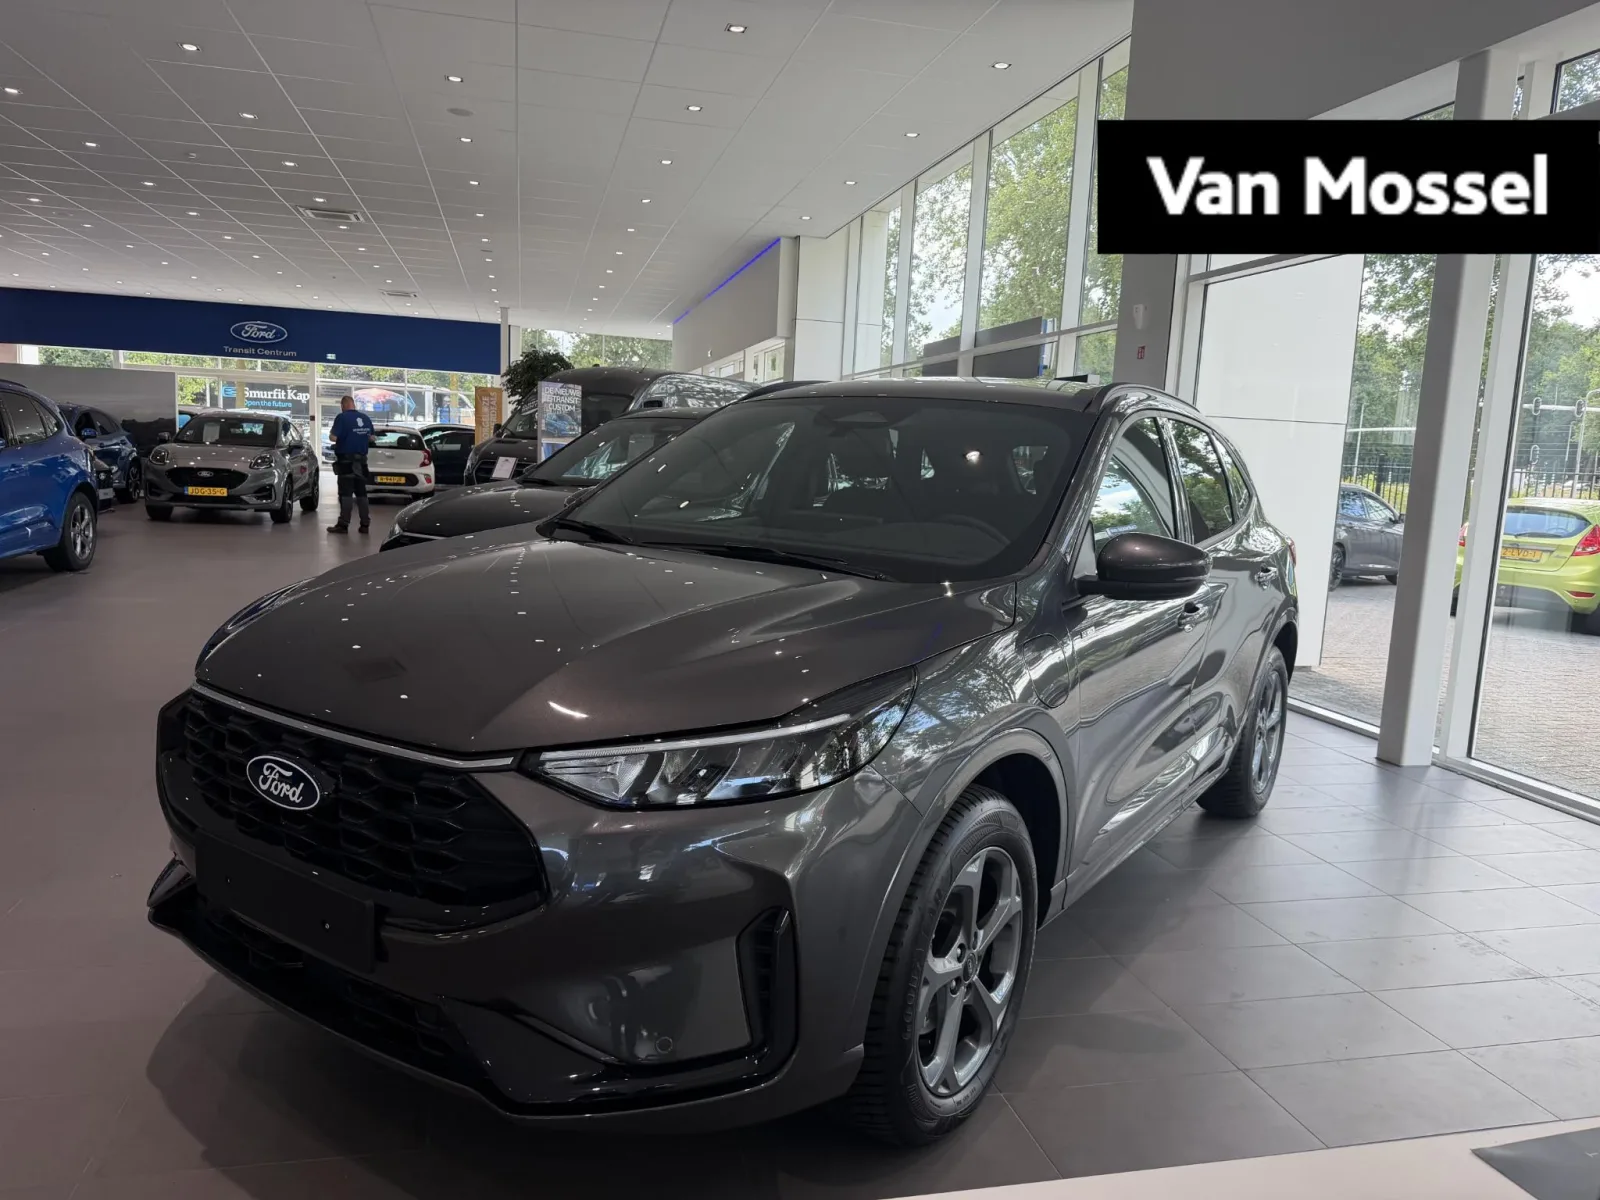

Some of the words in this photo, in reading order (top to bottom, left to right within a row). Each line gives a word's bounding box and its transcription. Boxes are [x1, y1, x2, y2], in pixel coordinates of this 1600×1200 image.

[241, 323, 276, 339] Ford
[223, 346, 255, 354] Transit
[257, 348, 297, 357] Centrum
[244, 387, 286, 399] Smurfit
[544, 386, 554, 394] DE
[548, 403, 576, 412] CUSTOM
[258, 762, 304, 803] Ford
